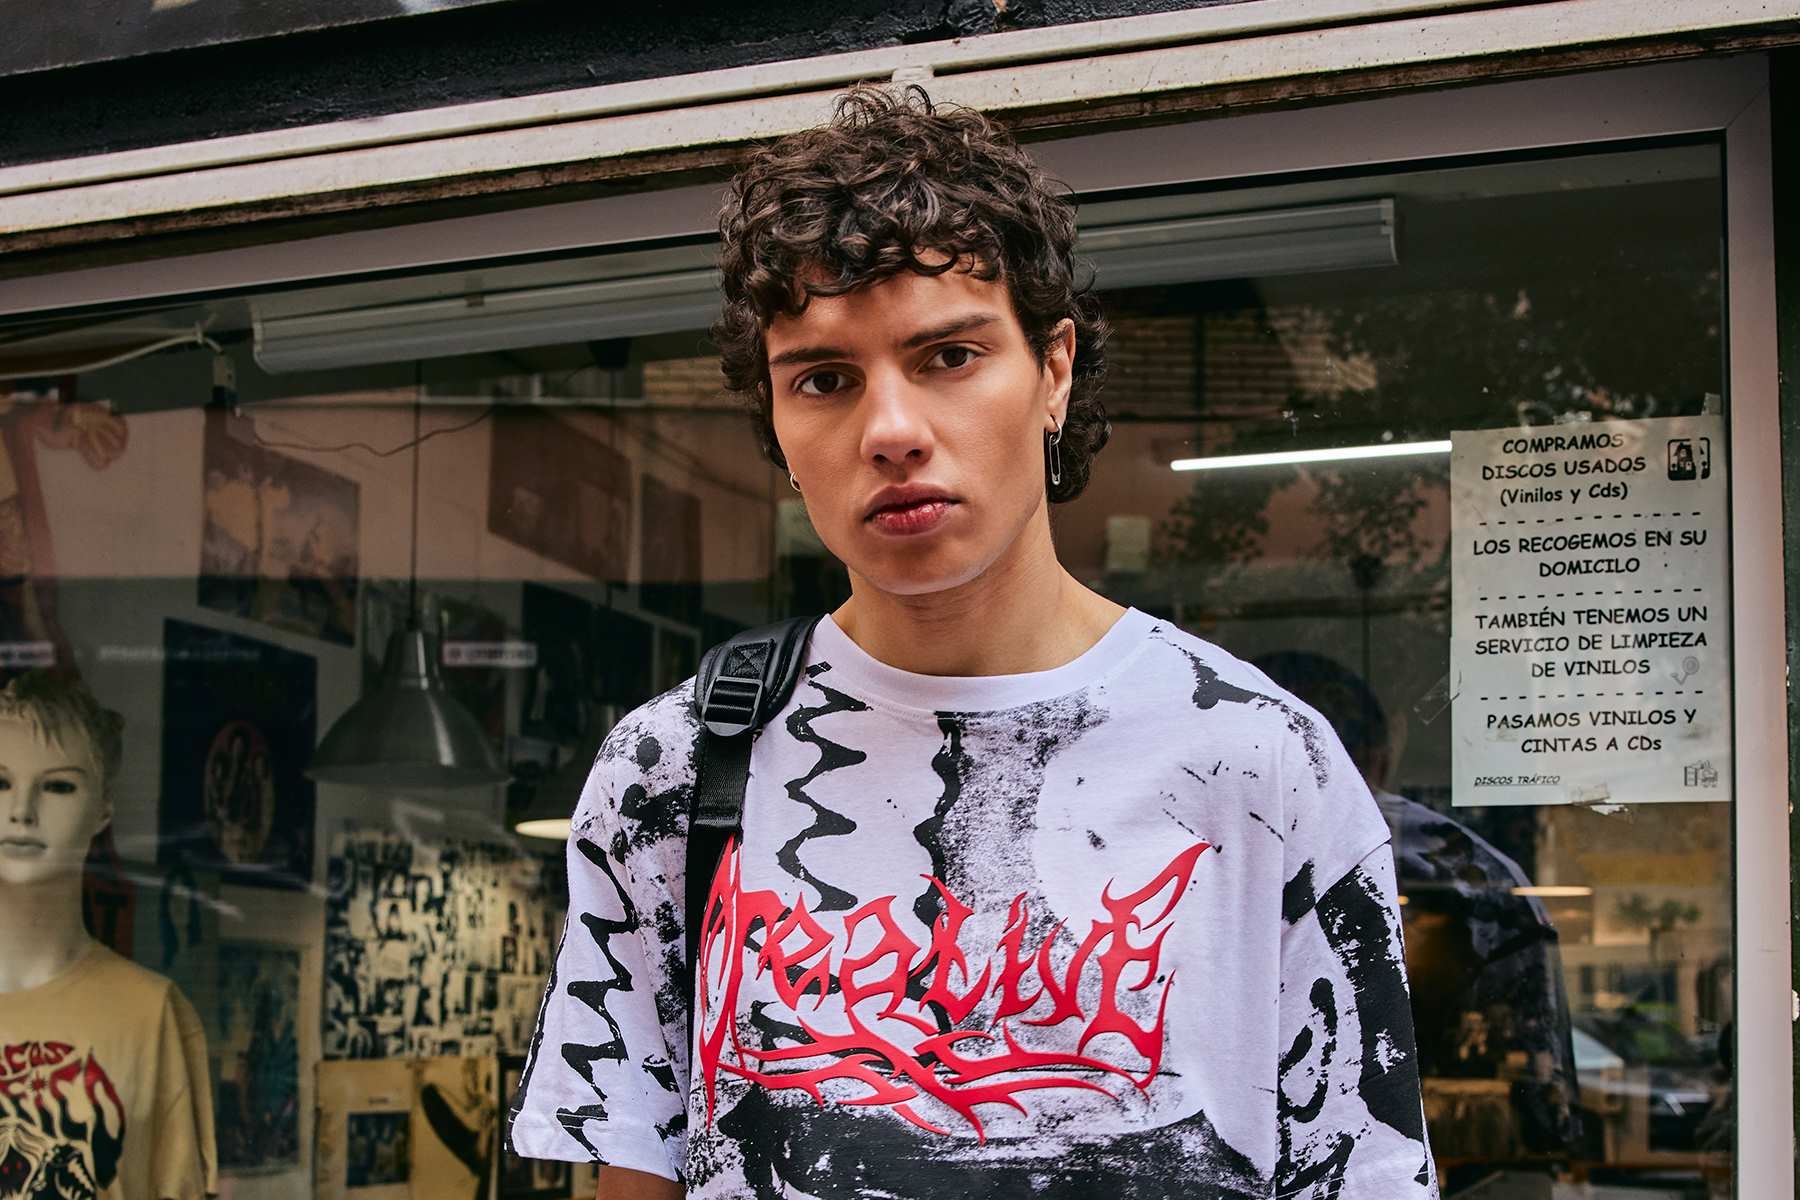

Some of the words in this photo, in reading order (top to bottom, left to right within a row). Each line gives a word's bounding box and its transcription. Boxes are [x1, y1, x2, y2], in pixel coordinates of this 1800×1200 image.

[1503, 434, 1623, 454] COMPRAMOS
[1482, 463, 1557, 480] DISCOS
[1564, 456, 1646, 475] USADOS
[1500, 487, 1563, 507] (Vinilos
[1570, 489, 1581, 504] y
[1589, 482, 1628, 500] Cds)
[1474, 539, 1511, 555] LOS
[1519, 532, 1637, 553] RECOGEMOS
[1645, 531, 1672, 547] EN
[1680, 530, 1707, 546] SU
[1539, 558, 1640, 577] DOMICILO
[1475, 606, 1565, 629] TAMBIÉN
[1573, 608, 1670, 625] TENEMOS
[1678, 606, 1707, 622] UN
[1475, 637, 1569, 655] SERVICIO
[1578, 634, 1602, 650] DE
[1611, 632, 1707, 649] LIMPIEZA
[1532, 662, 1555, 677] DE
[1564, 659, 1650, 676] VINILOS
[1487, 712, 1580, 729] PASAMOS
[1589, 710, 1676, 726] VINILOS
[1684, 709, 1696, 724] Y
[1521, 737, 1597, 753] CINTAS
[1606, 737, 1618, 751] A
[1628, 735, 1661, 751] CDs
[1474, 776, 1514, 787] DISCOS
[1517, 773, 1561, 785] TRÁFICO
